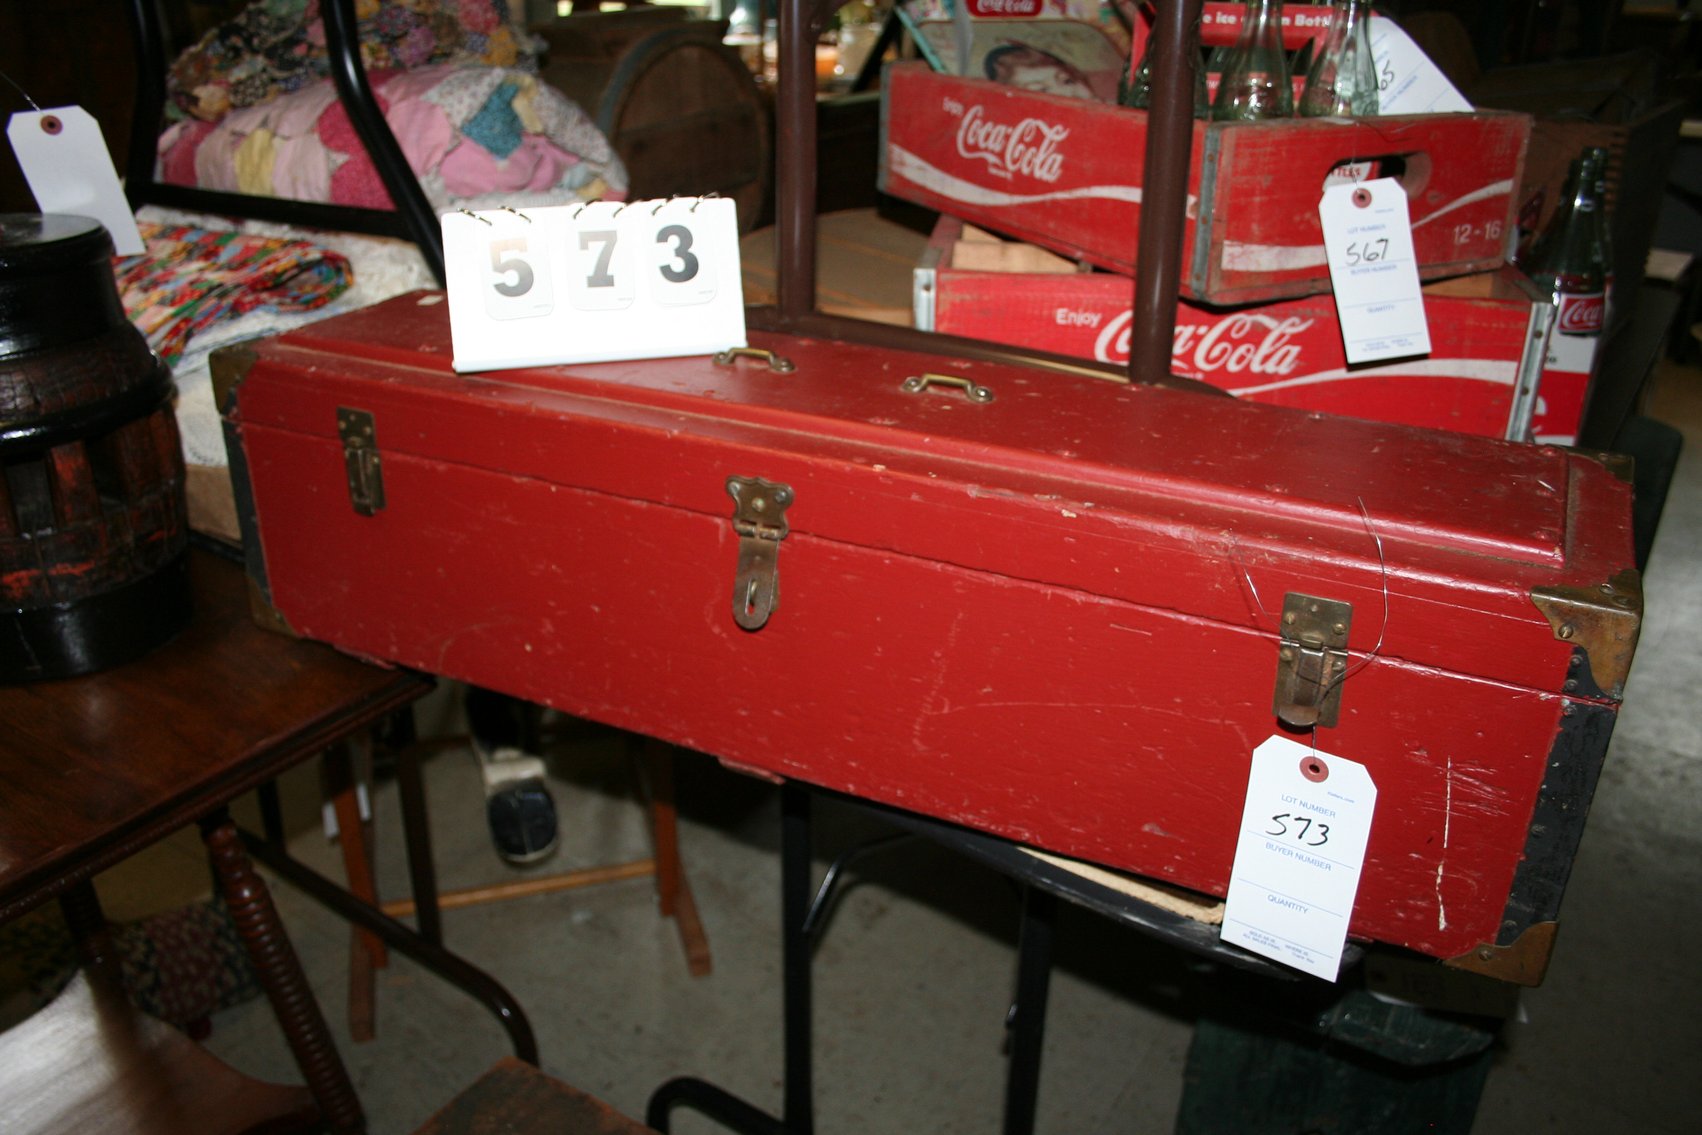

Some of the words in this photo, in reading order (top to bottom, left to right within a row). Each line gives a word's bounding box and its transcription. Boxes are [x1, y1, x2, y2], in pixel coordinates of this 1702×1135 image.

[1377, 59, 1395, 91] 65
[956, 104, 1070, 183] Coca-Cola
[1346, 238, 1389, 266] 567
[1055, 307, 1102, 329] Enjoy
[1281, 793, 1298, 805] LOT
[1298, 799, 1336, 819] NUMBER
[1265, 813, 1330, 847] 573
[1265, 841, 1294, 858] BUYER
[1294, 851, 1332, 872] NUMBER
[1267, 893, 1309, 914] QUANTITY
